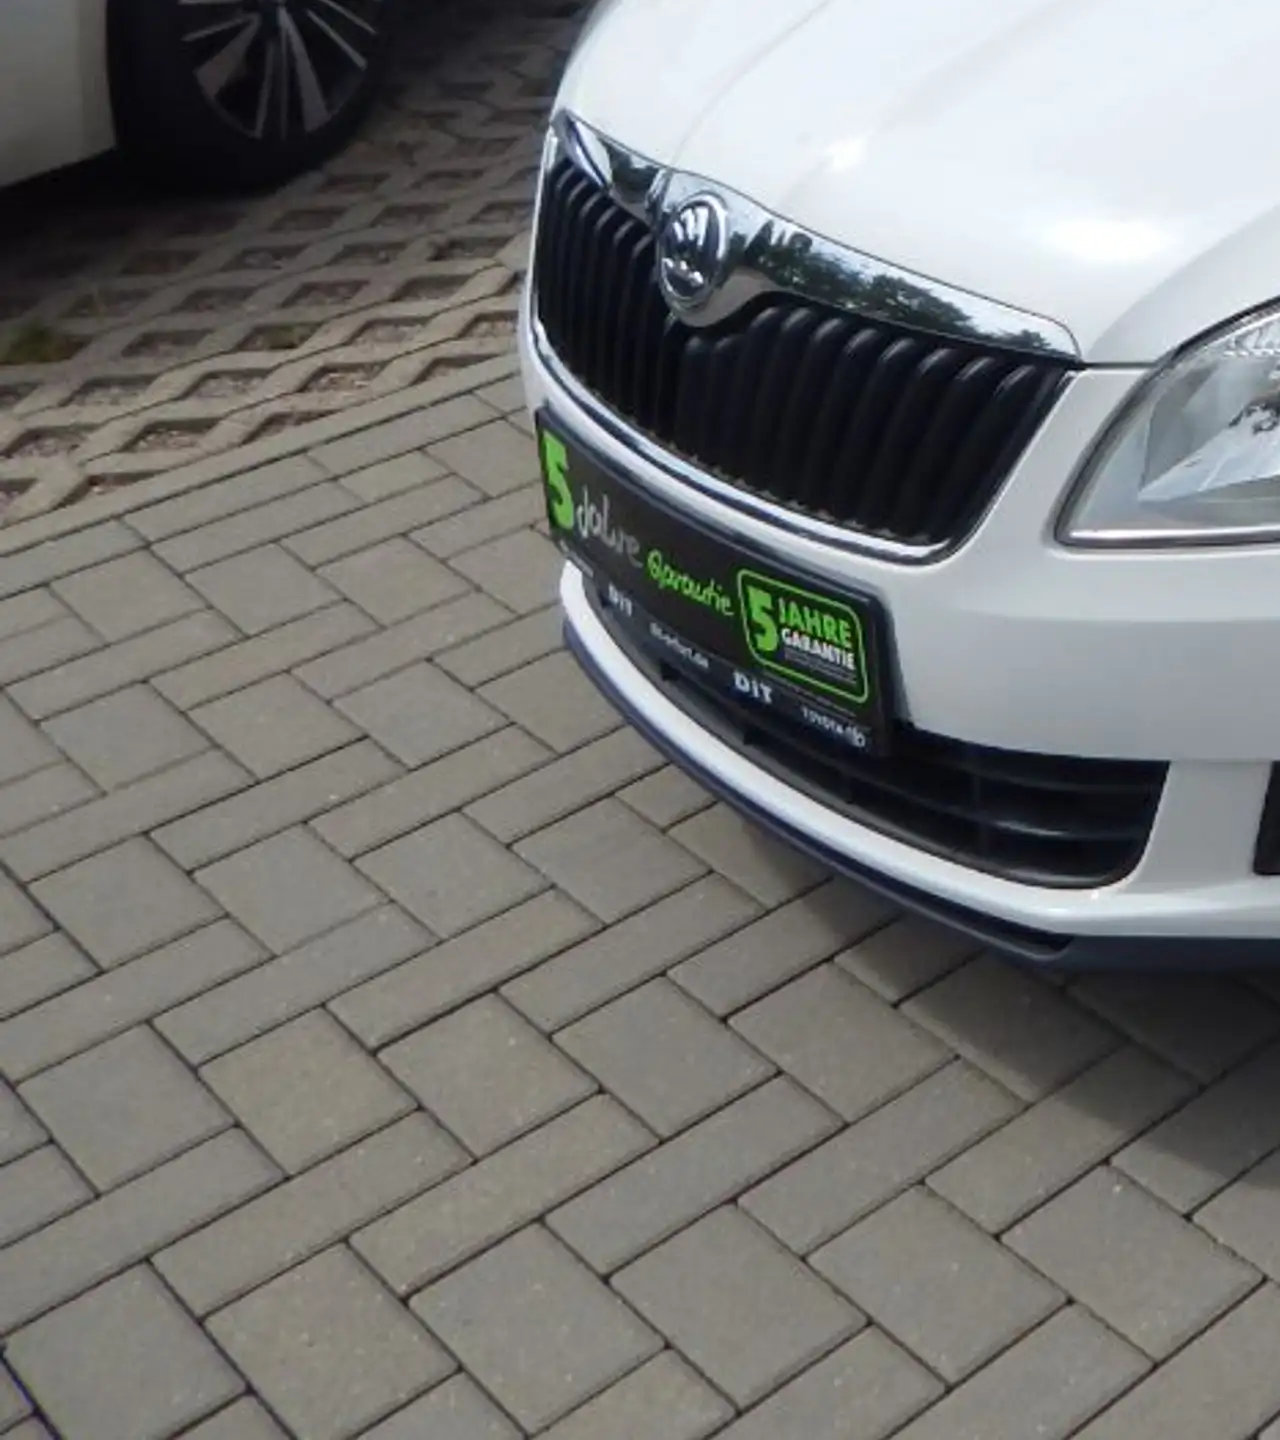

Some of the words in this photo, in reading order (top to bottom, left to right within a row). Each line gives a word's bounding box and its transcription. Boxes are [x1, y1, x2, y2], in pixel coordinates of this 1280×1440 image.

[543, 430, 574, 530] 5
[647, 548, 735, 616] Garantie
[746, 585, 779, 652] 5
[777, 597, 853, 648] JAHRE
[780, 627, 856, 671] GARANTIE
[732, 671, 774, 705] DIT
